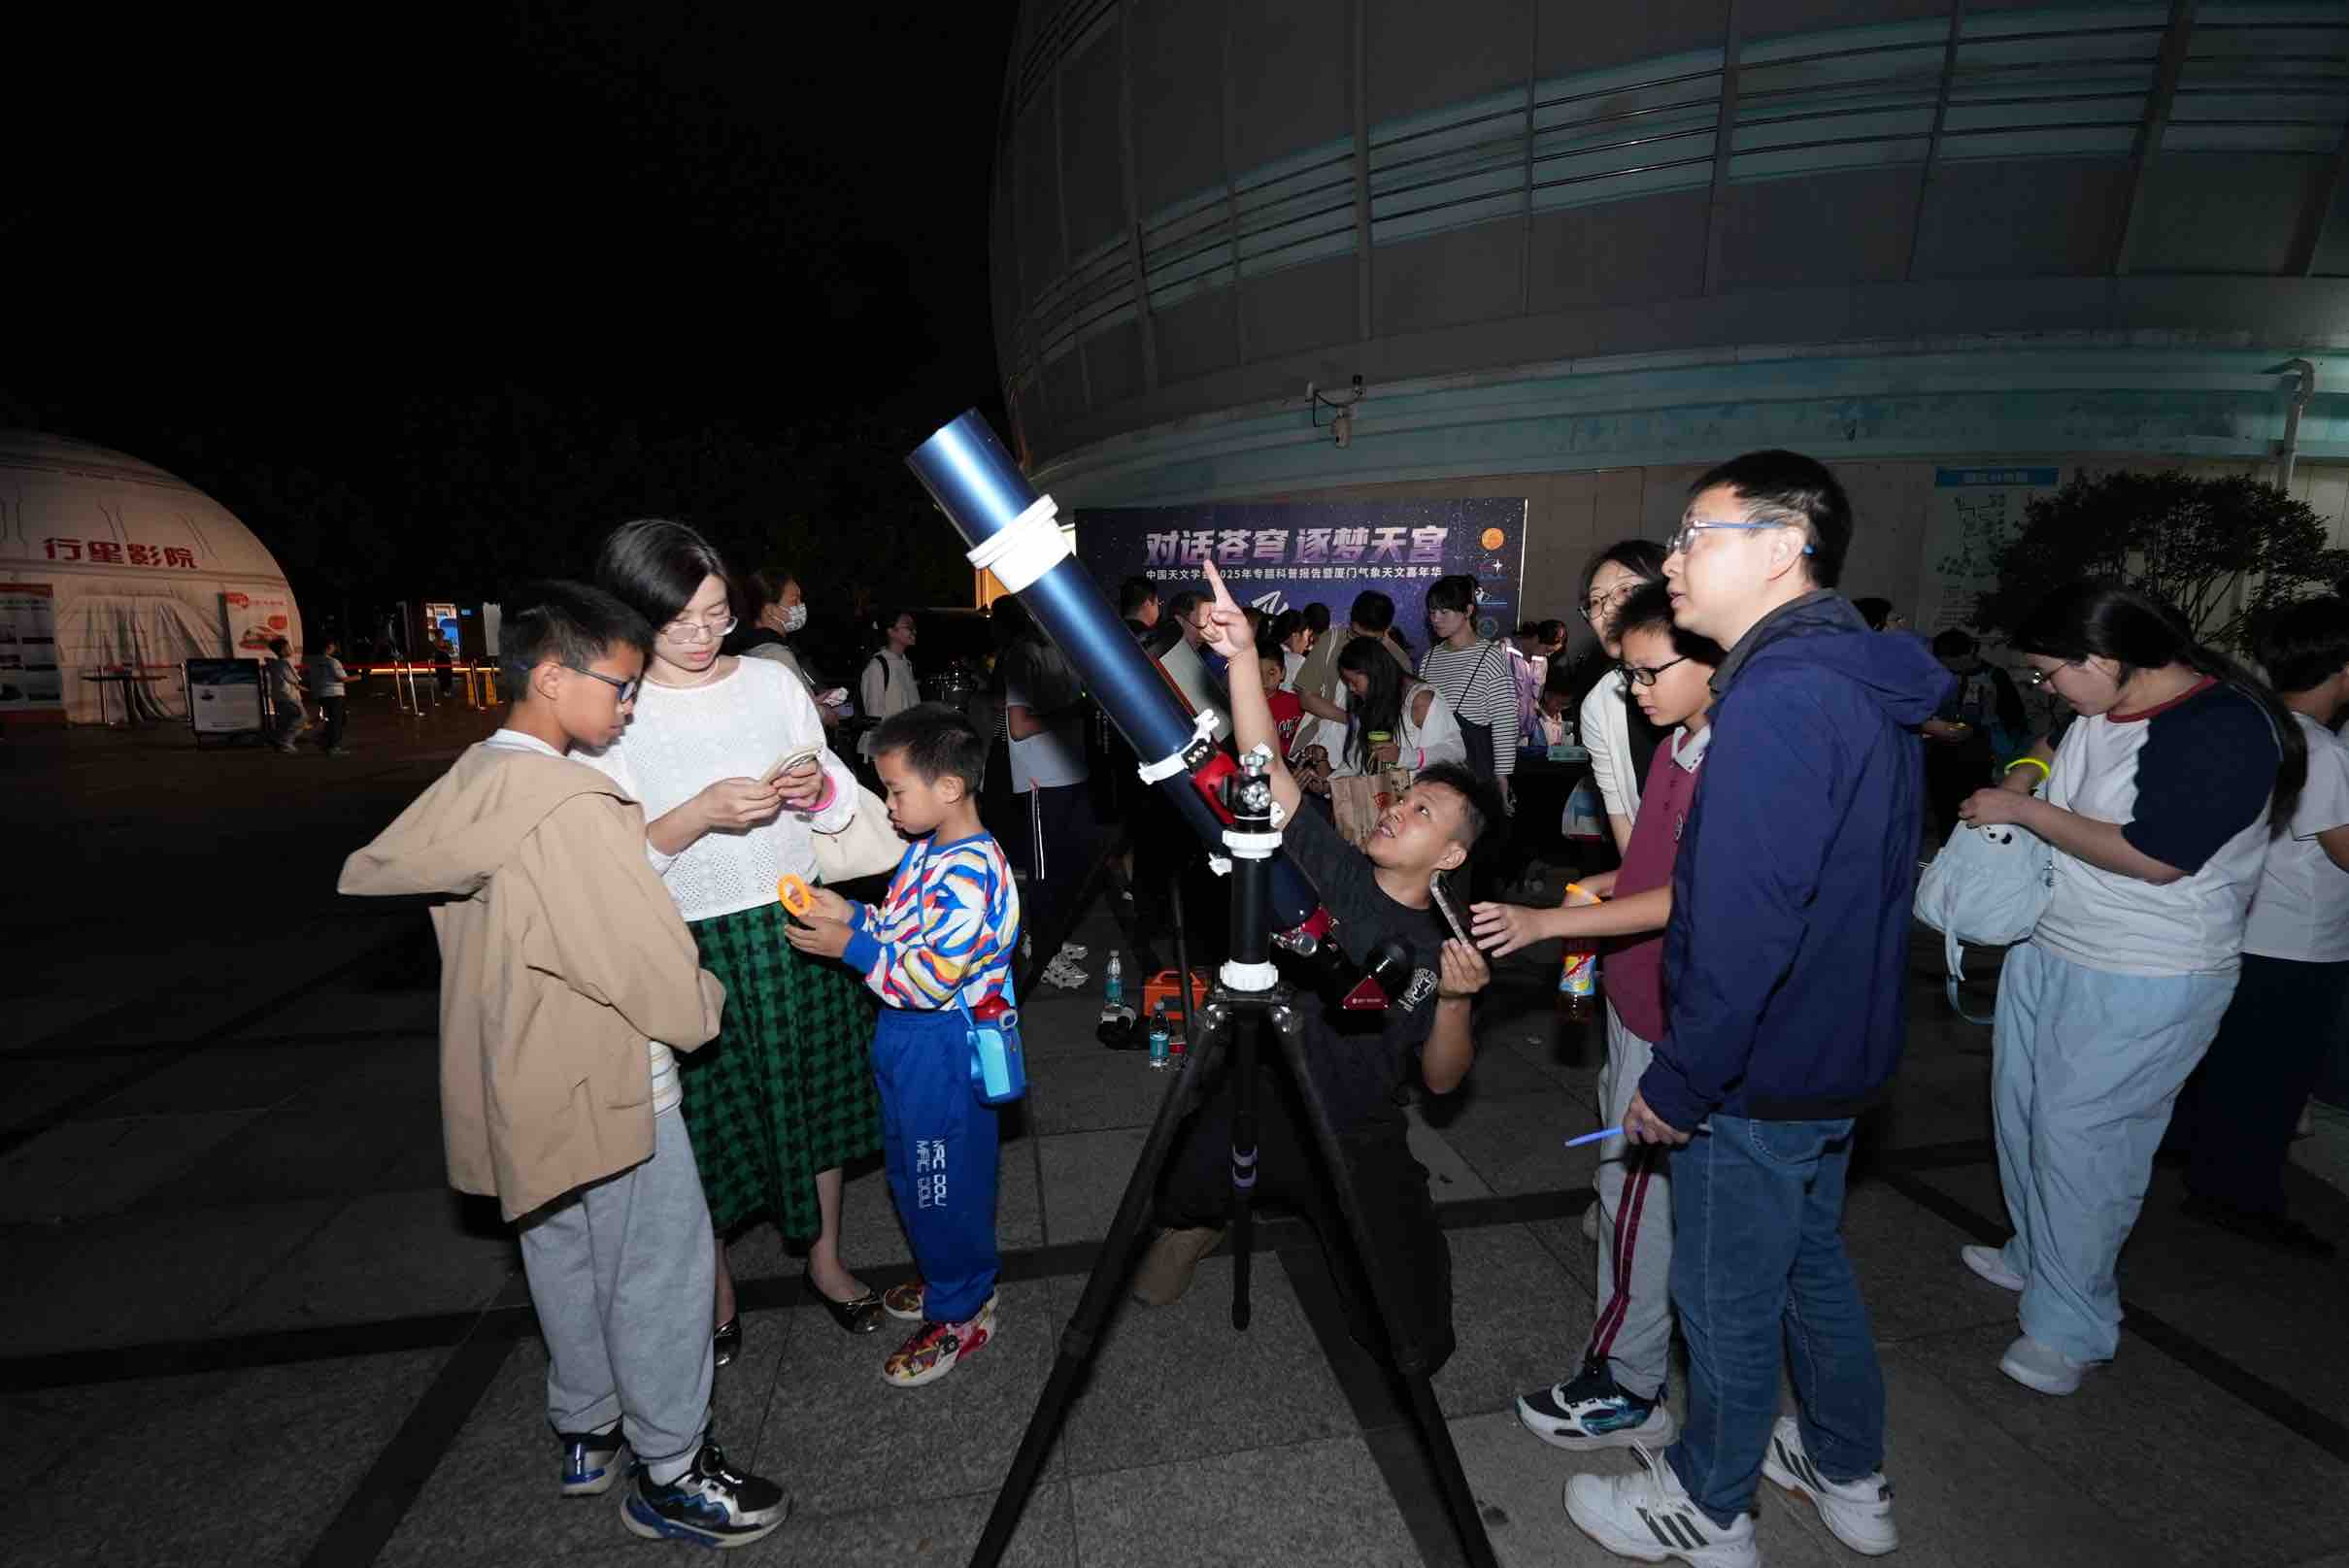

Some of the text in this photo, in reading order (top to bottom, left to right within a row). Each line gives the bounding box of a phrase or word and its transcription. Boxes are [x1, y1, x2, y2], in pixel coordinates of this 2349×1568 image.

[44, 537, 197, 568] 行星影院
[1144, 525, 1448, 565] 对话苍穹 逐梦天宫
[1146, 567, 1442, 580] 中国天文学025年专题科普报告暨厦门气象天文嘉年华
